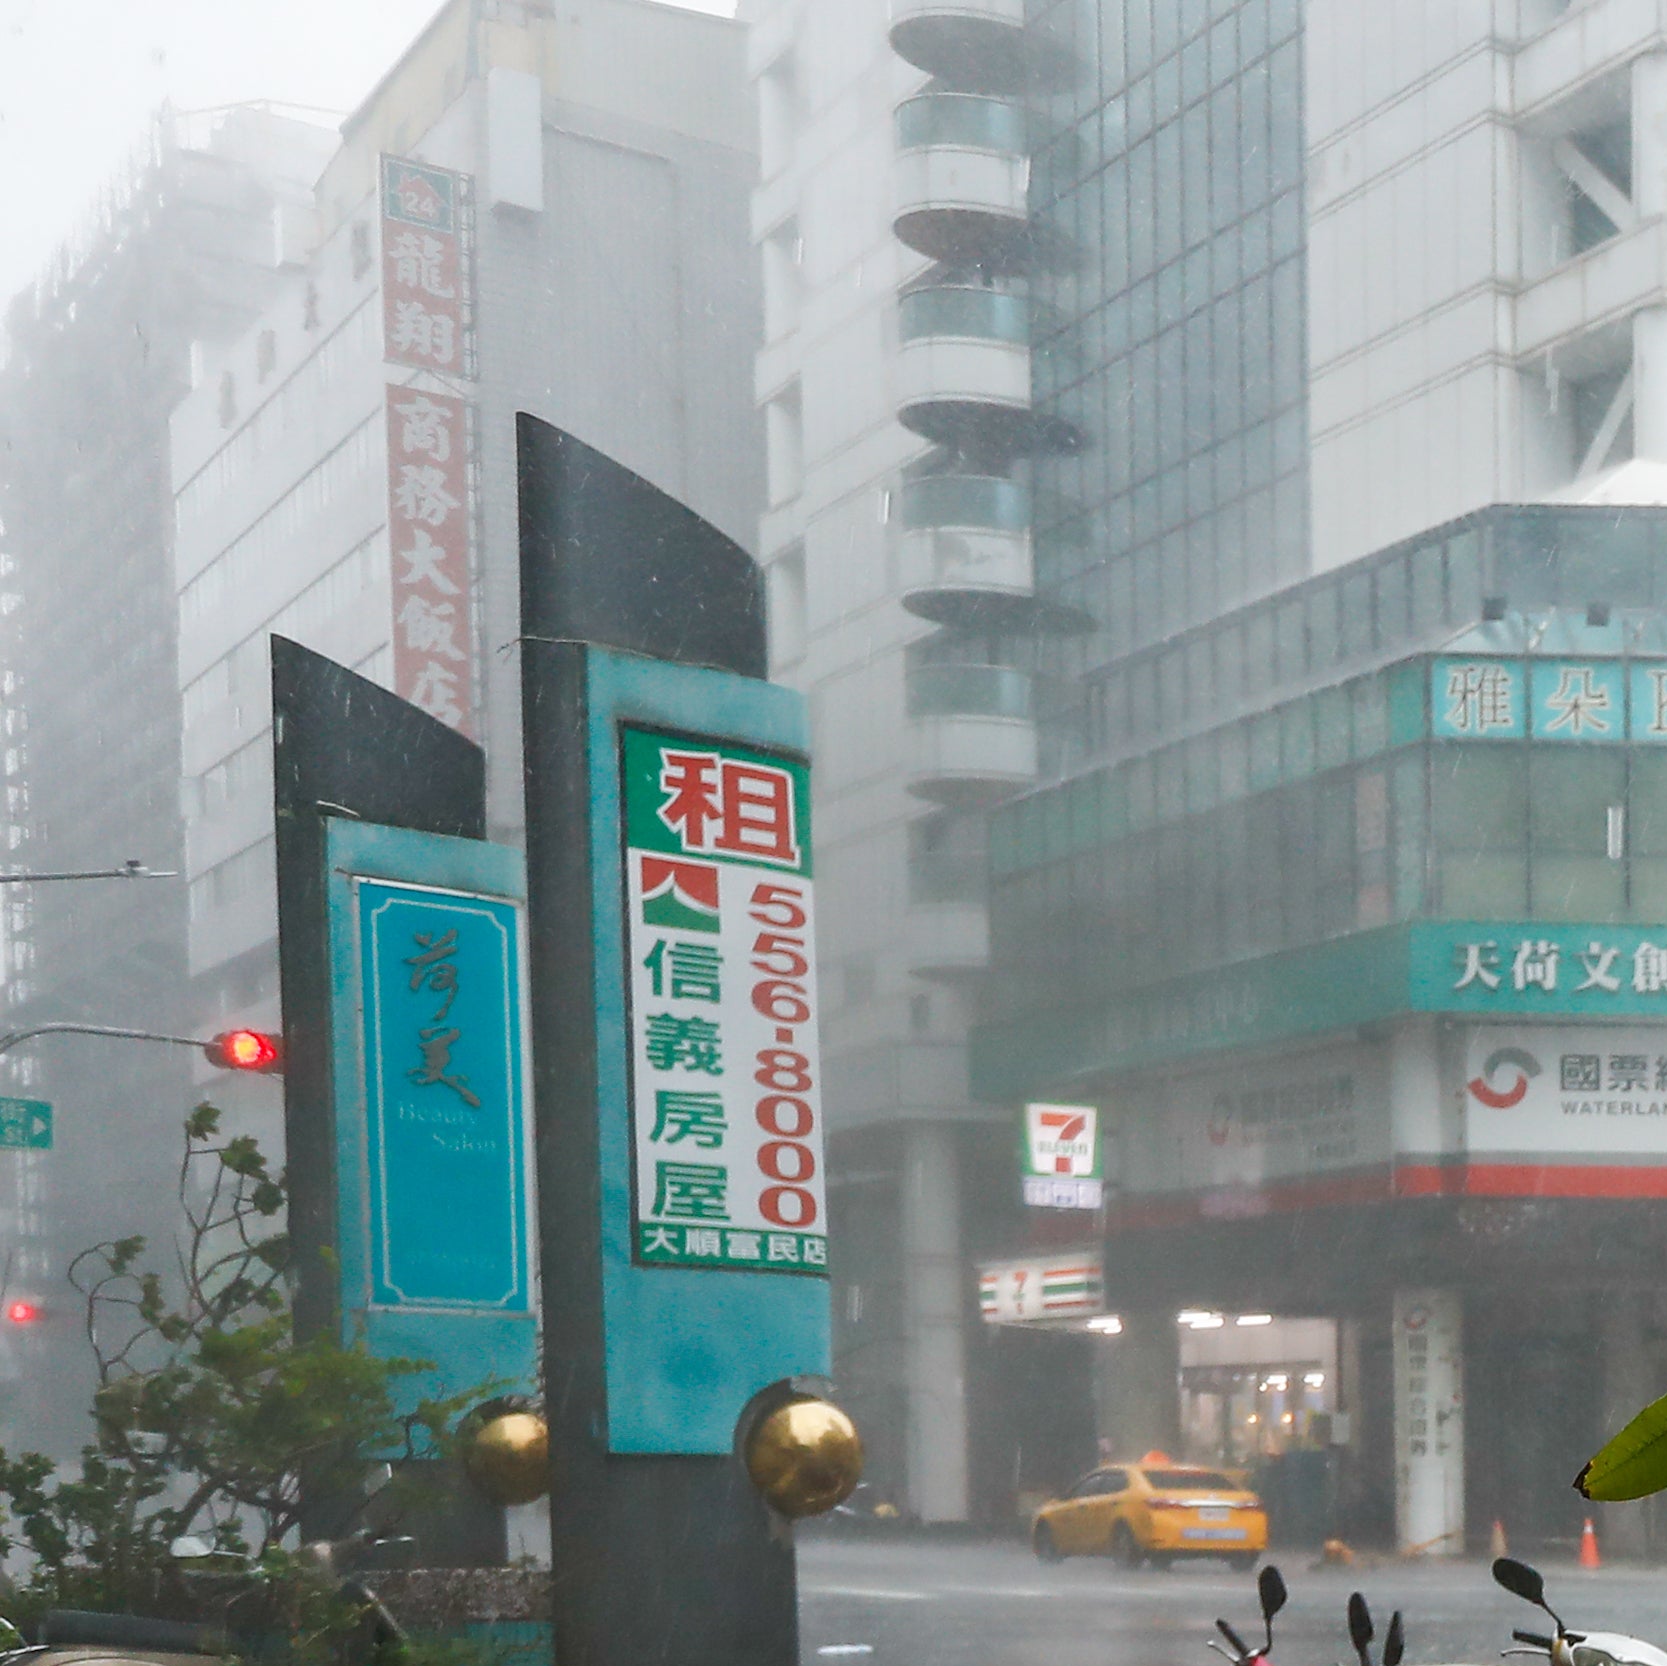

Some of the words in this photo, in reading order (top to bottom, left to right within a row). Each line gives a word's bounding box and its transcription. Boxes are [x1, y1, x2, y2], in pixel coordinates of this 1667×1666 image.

[404, 191, 435, 218] 24
[389, 235, 455, 365] 龍翔
[394, 394, 464, 735] 商務大飯店
[660, 750, 800, 868] 租
[642, 939, 732, 1223] 信義房屋
[1040, 1112, 1086, 1173] 7
[643, 1227, 828, 1267] 大順富民店
